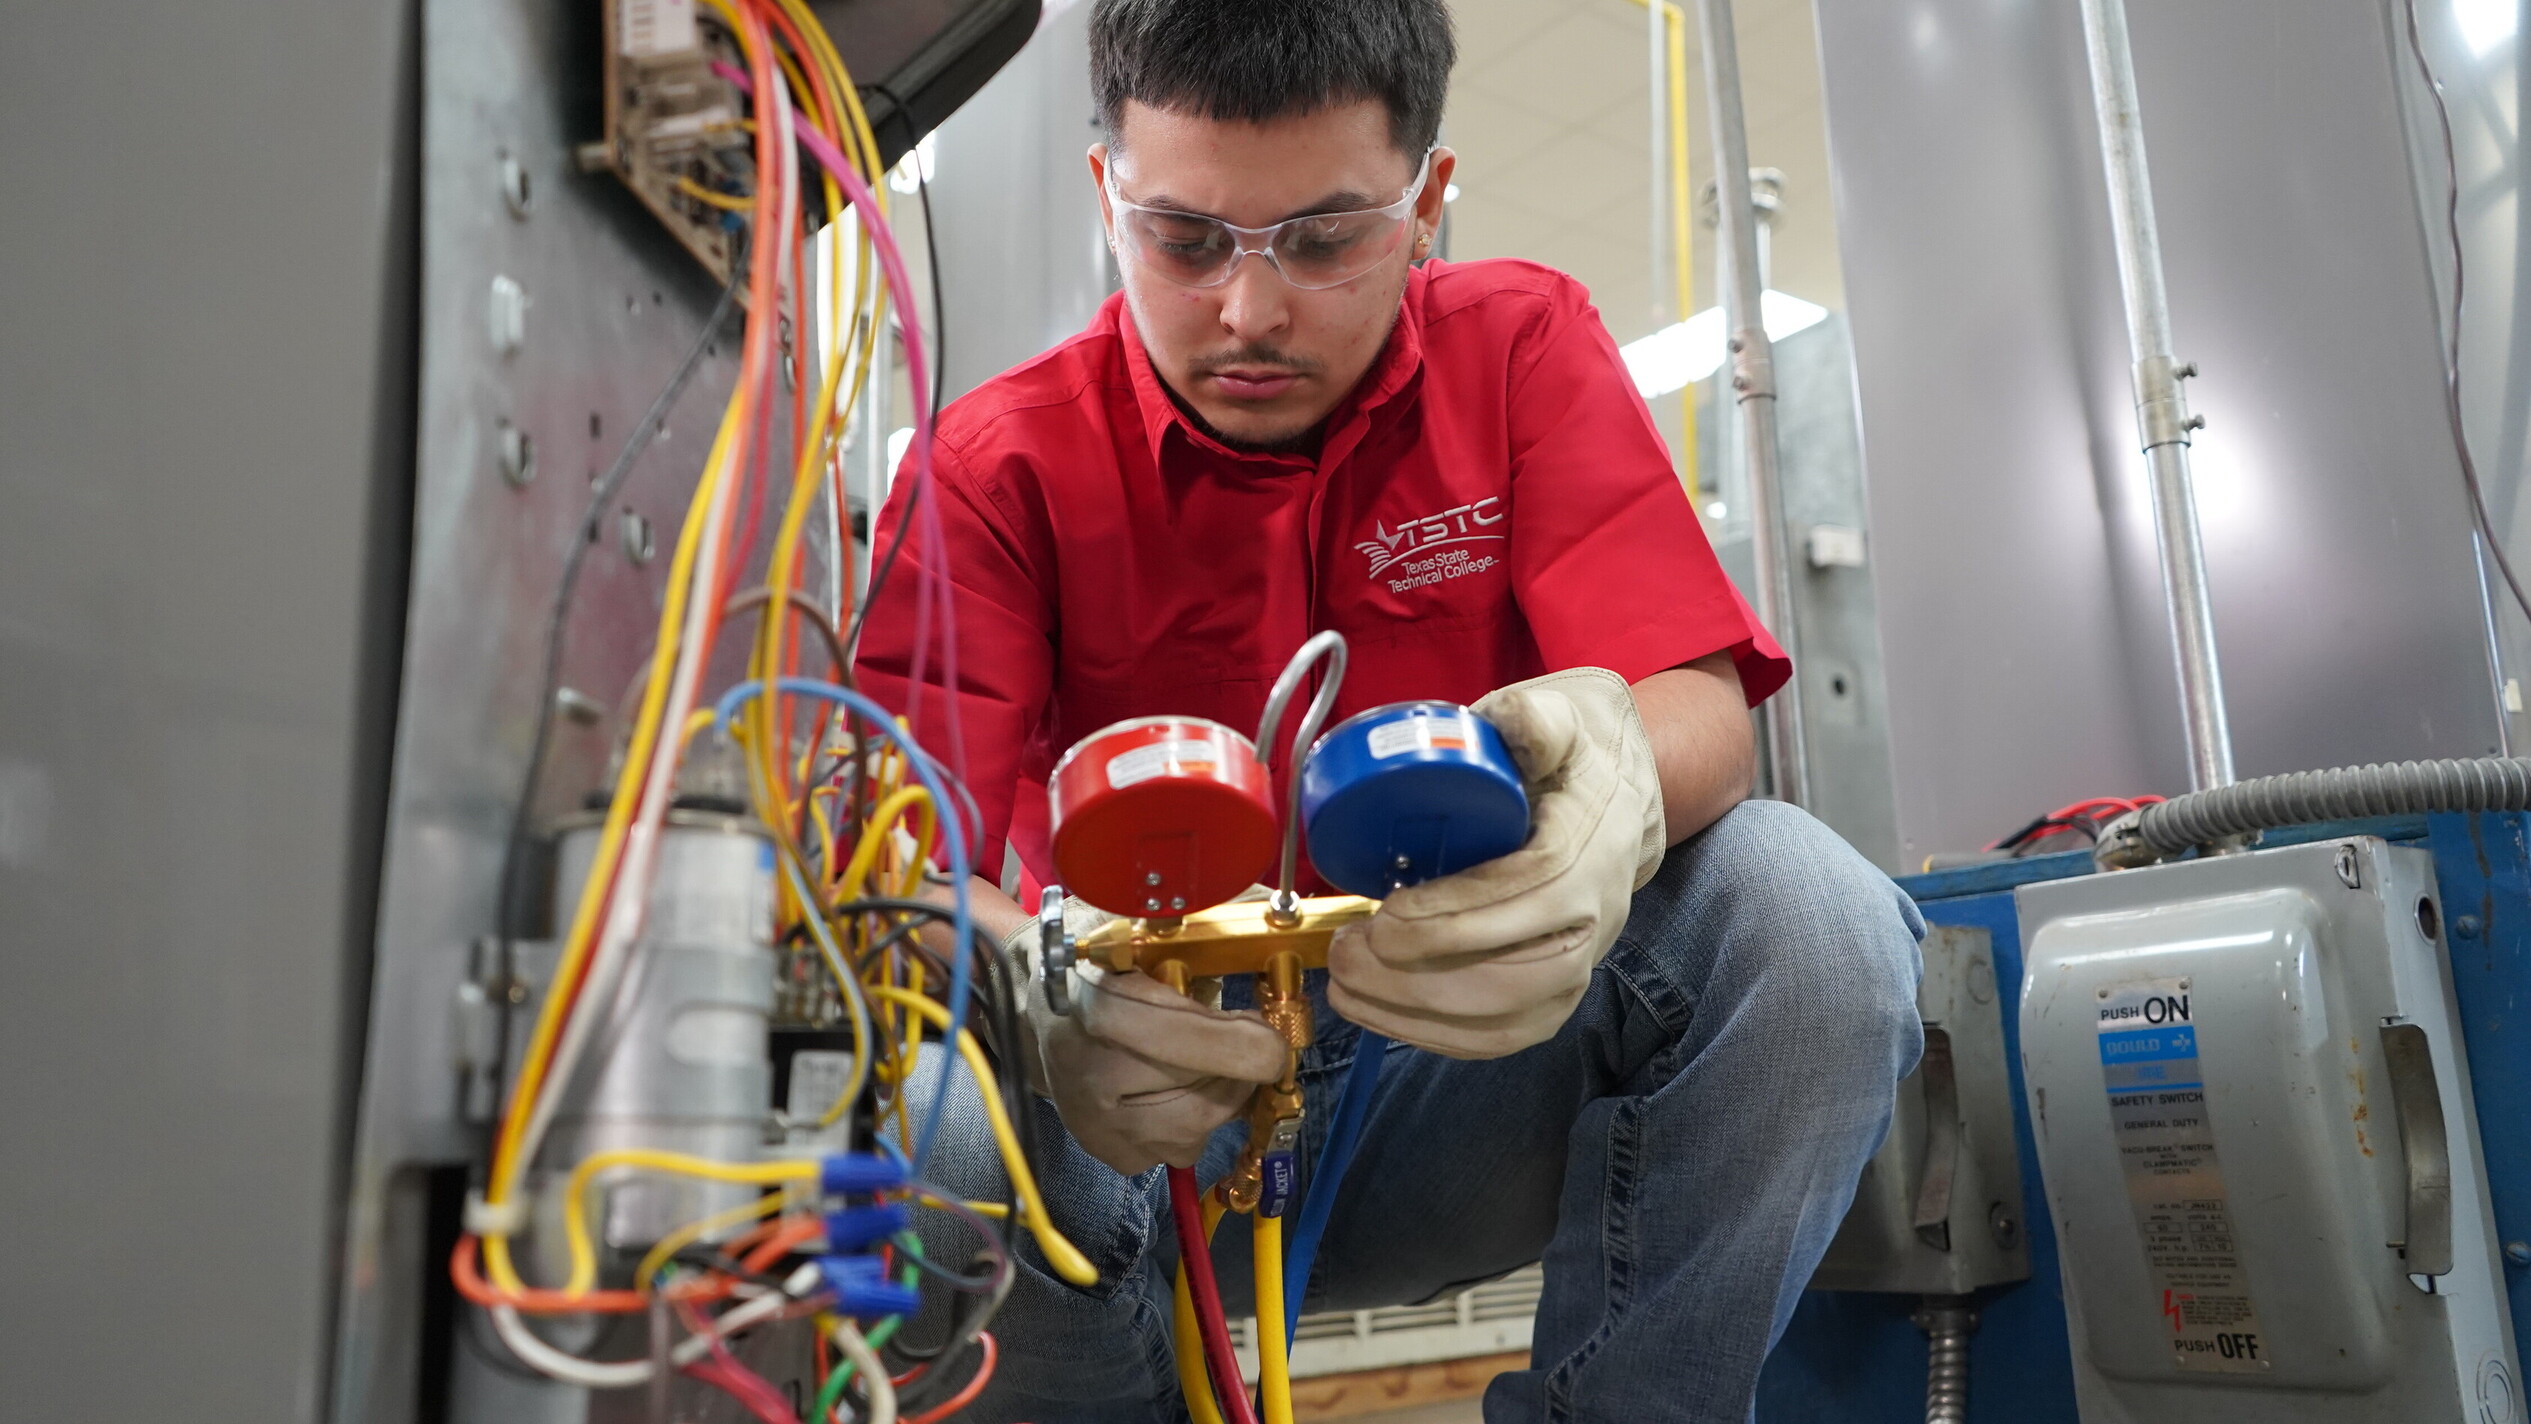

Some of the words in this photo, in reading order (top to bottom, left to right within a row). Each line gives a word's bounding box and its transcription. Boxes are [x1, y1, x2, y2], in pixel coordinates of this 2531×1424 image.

[1397, 496, 1504, 547] TSTC
[1388, 570, 1443, 594] Technical
[1444, 555, 1494, 579] College
[1401, 558, 1436, 576] Texas
[1436, 549, 1470, 568] State
[2101, 1006, 2139, 1020] PUSH
[2144, 994, 2189, 1024] ON
[2111, 1095, 2153, 1107] SAFETY
[2159, 1092, 2204, 1105] SWITCH
[2124, 1120, 2168, 1130] GENERAL
[2172, 1118, 2199, 1128] DUTY
[2181, 1144, 2213, 1152] SWITCH
[2174, 1339, 2216, 1353] PUSH
[2216, 1332, 2259, 1360] OFF
